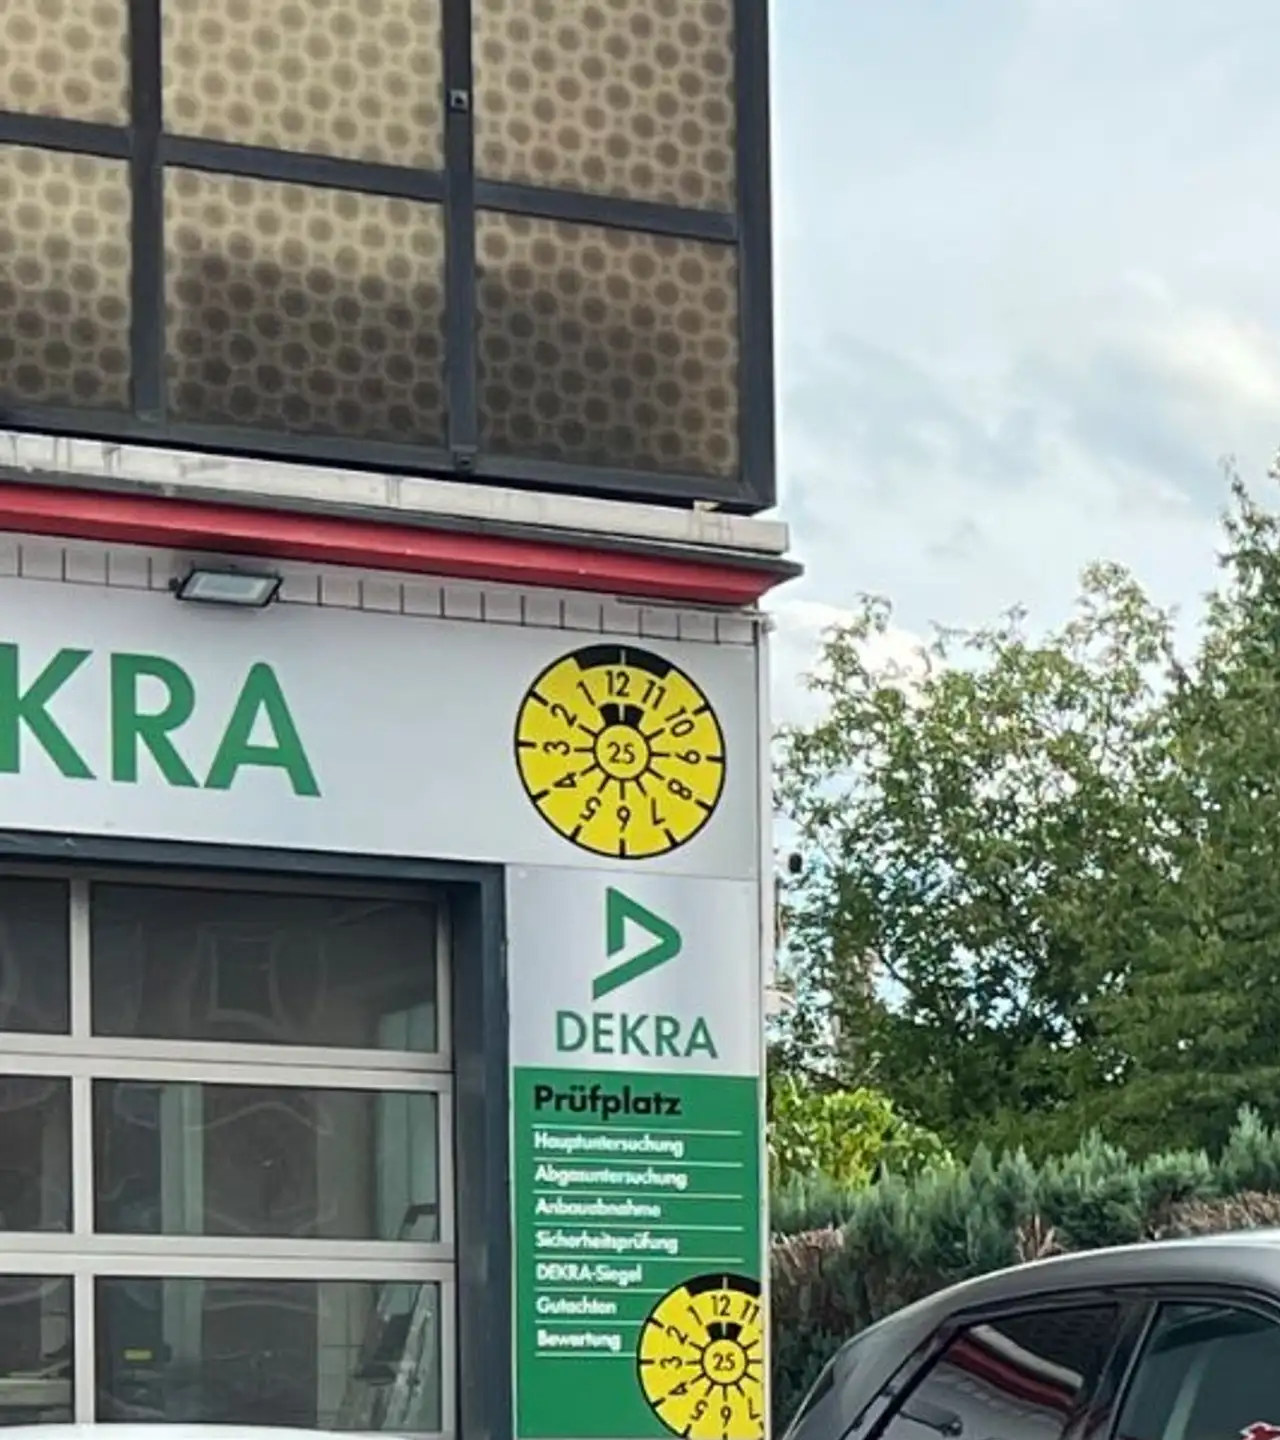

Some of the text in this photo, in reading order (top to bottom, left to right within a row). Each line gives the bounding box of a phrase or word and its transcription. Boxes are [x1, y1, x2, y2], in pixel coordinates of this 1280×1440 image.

[576, 680, 596, 705] 1
[605, 670, 630, 697] 12
[642, 679, 666, 710] 11
[0, 642, 322, 797] KRA
[551, 703, 577, 727] 2
[665, 706, 695, 737] 10
[543, 740, 570, 755] 3
[607, 742, 635, 764] 25
[675, 750, 700, 764] 9
[553, 772, 577, 788] 4
[667, 778, 692, 800] 8
[579, 796, 601, 821] 5
[651, 797, 665, 825] 7
[556, 1010, 718, 1059] DEKRA
[534, 1084, 682, 1120] Prüfplatz
[534, 1131, 684, 1158] Hauptuntersuchung
[535, 1164, 688, 1190] Abgasuntersuchung
[535, 1229, 678, 1254] Sicherheitsprüfung
[536, 1263, 642, 1286] DEKRA-Siegel
[536, 1296, 617, 1314] Gutachten
[687, 1305, 702, 1326] 1
[711, 1295, 731, 1317] 12
[740, 1300, 760, 1325] 11
[537, 1329, 622, 1352] Bewertung
[666, 1325, 689, 1345] 2
[660, 1356, 683, 1369] 3
[713, 1352, 736, 1371] 25
[668, 1382, 688, 1395] 4
[690, 1399, 708, 1421] 5
